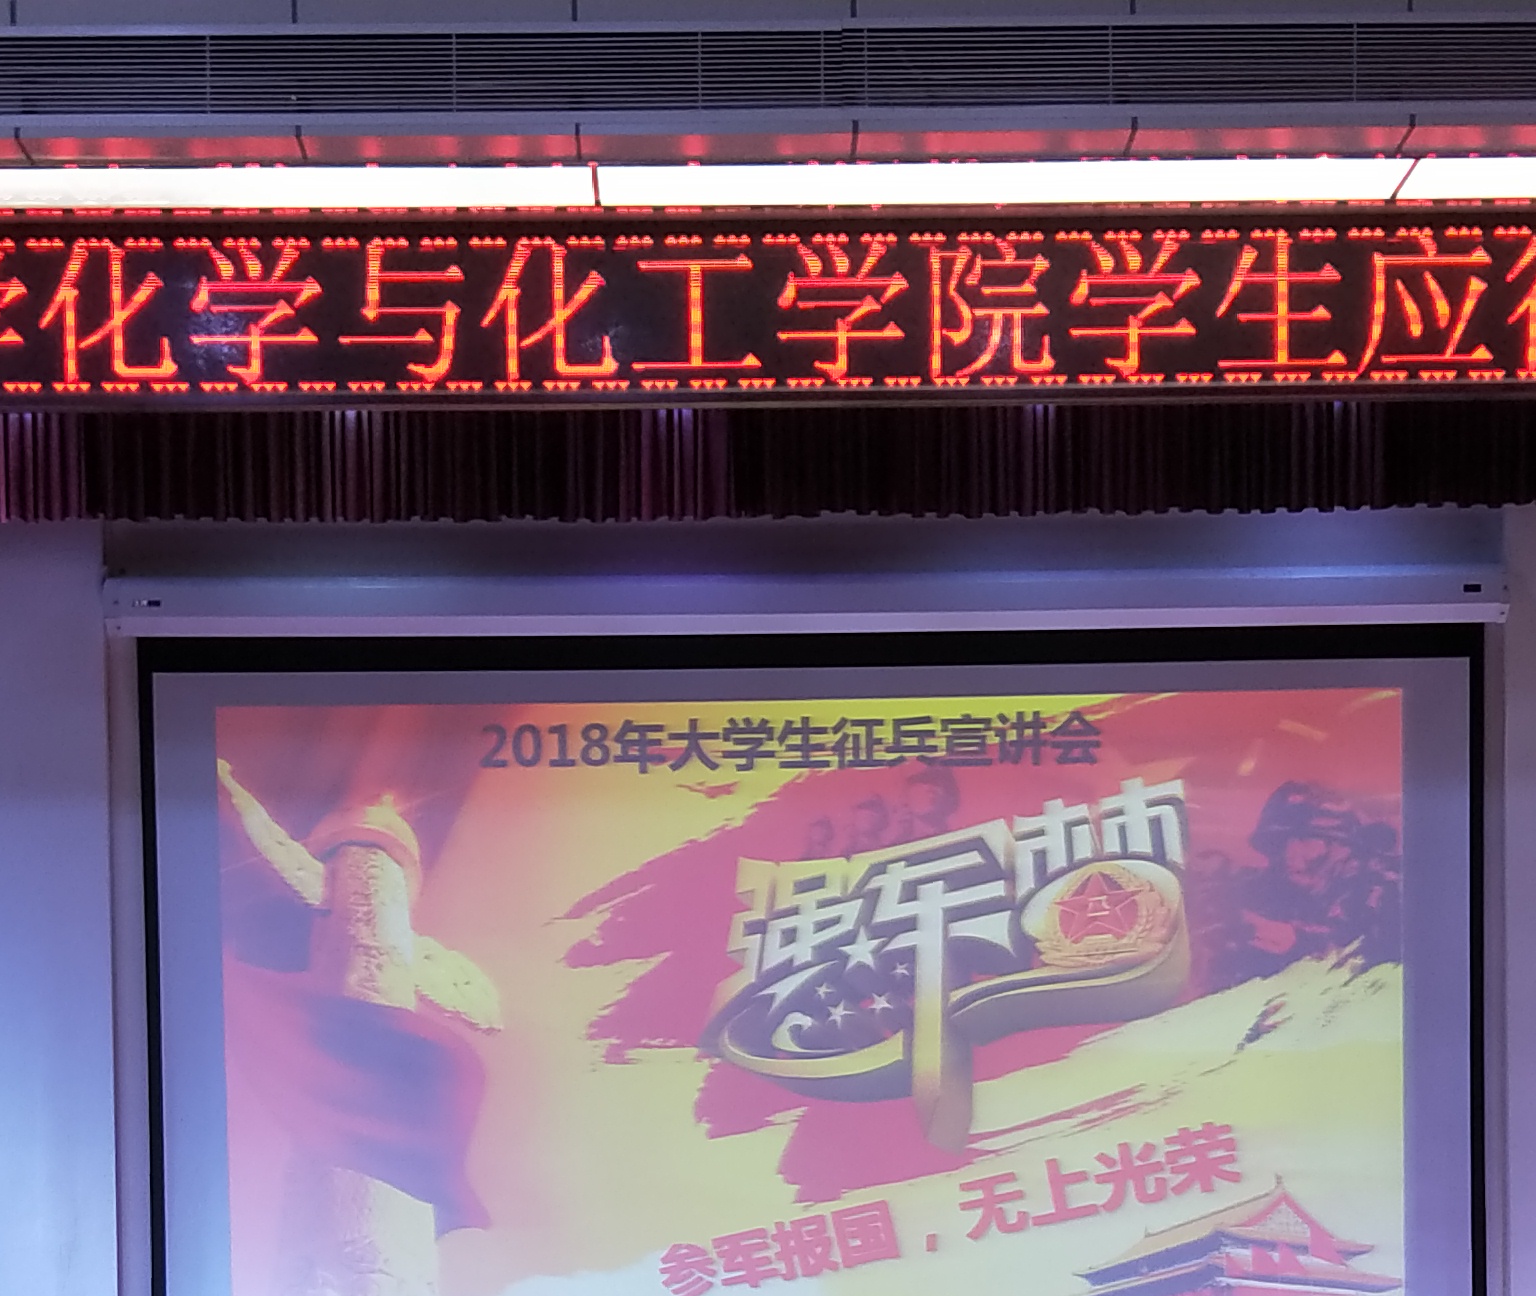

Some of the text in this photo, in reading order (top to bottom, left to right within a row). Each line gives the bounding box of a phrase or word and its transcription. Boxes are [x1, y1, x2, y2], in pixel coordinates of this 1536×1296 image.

[481, 711, 1102, 774] 2018年大学生征兵宣讲会
